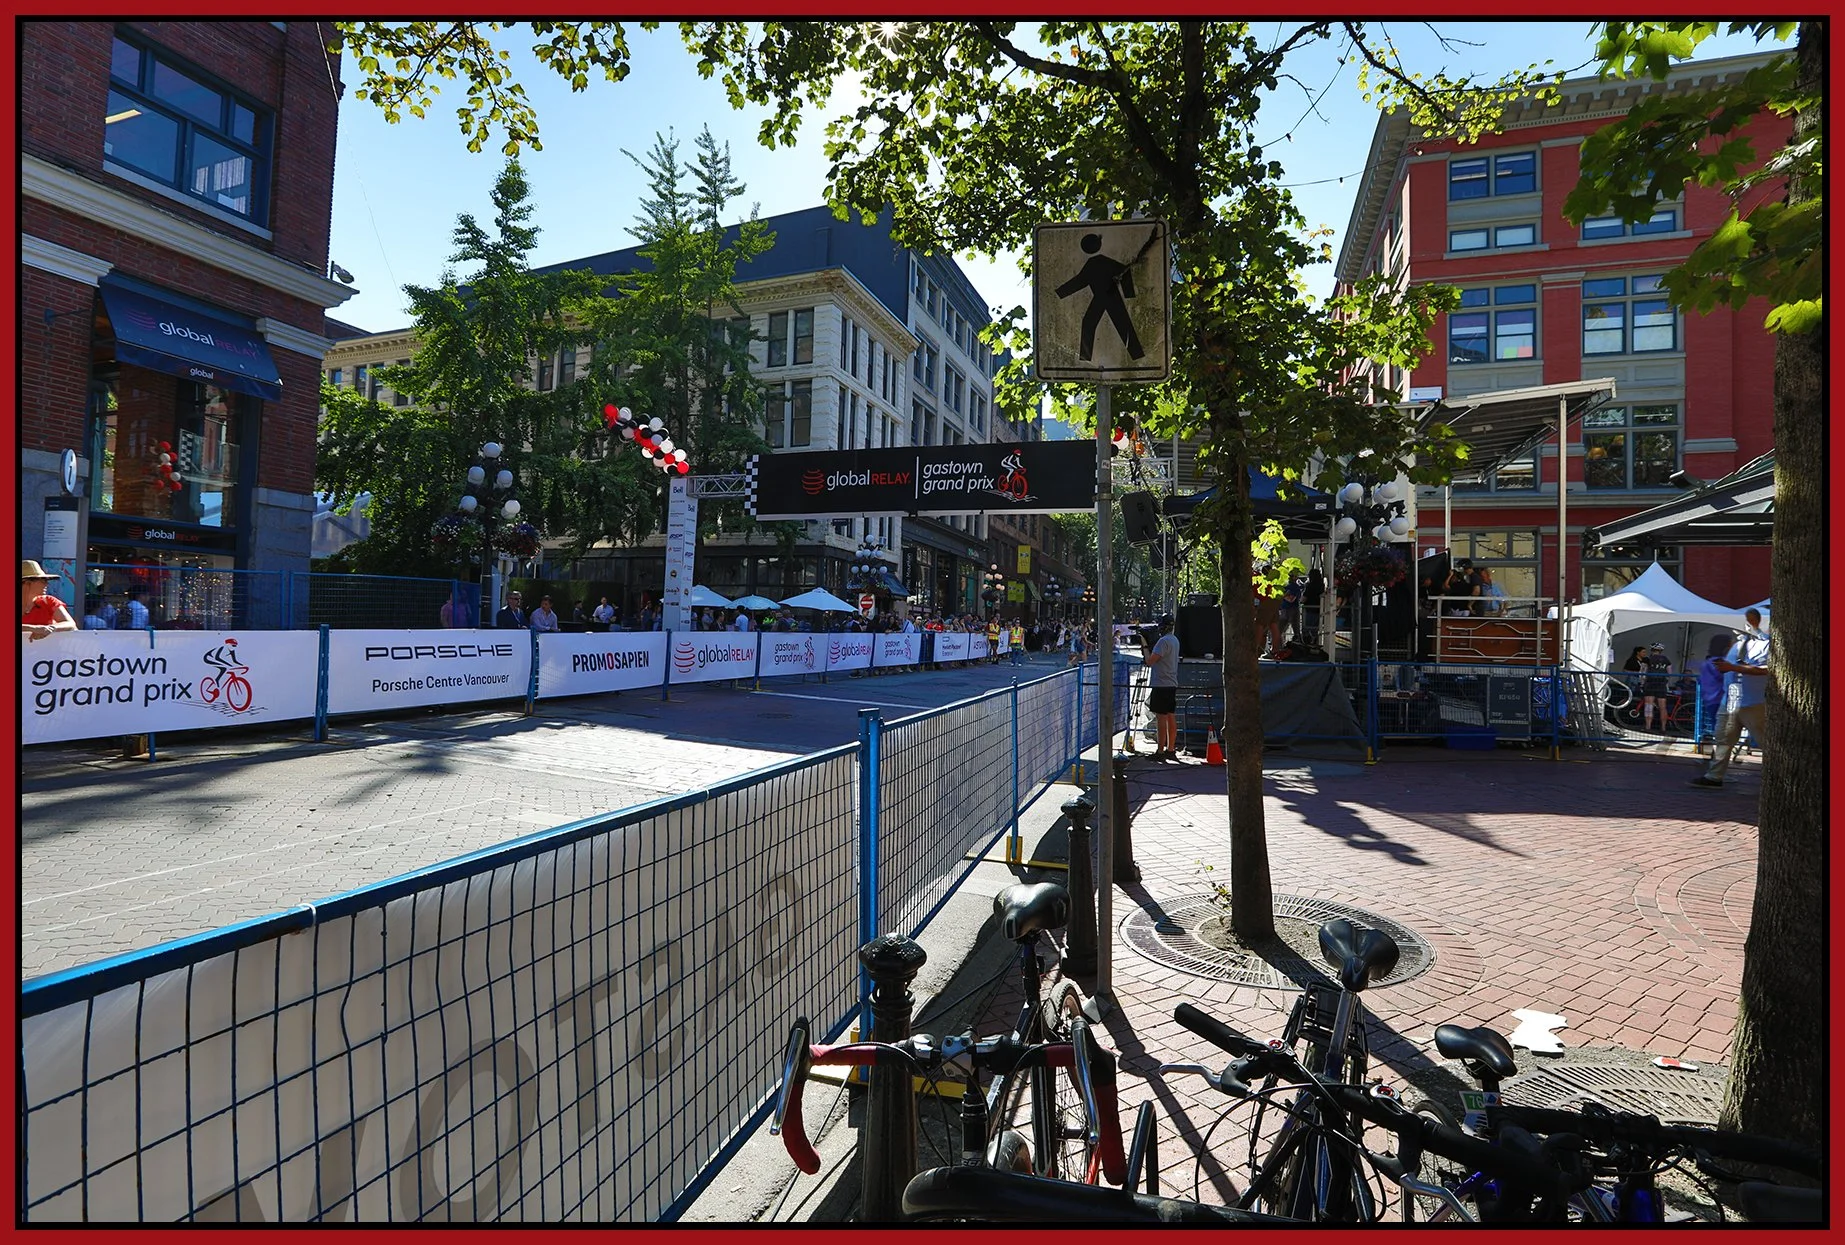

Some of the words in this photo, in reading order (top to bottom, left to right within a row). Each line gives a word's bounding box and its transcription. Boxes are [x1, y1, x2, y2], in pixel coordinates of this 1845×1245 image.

[922, 459, 983, 479] gastown
[672, 486, 683, 494] Bell
[922, 476, 965, 494] grand
[967, 475, 995, 493] prix
[365, 643, 513, 662] PORSCHE
[774, 641, 800, 655] gastown
[572, 650, 650, 673] PROMOSAPIEN
[774, 652, 793, 666] grand
[792, 652, 803, 665] prix
[31, 653, 167, 686] gastown
[372, 678, 424, 693] Porsche
[426, 674, 463, 689] Centre
[465, 672, 510, 686] Vancouver
[34, 678, 135, 715] grand
[143, 678, 193, 708] prix
